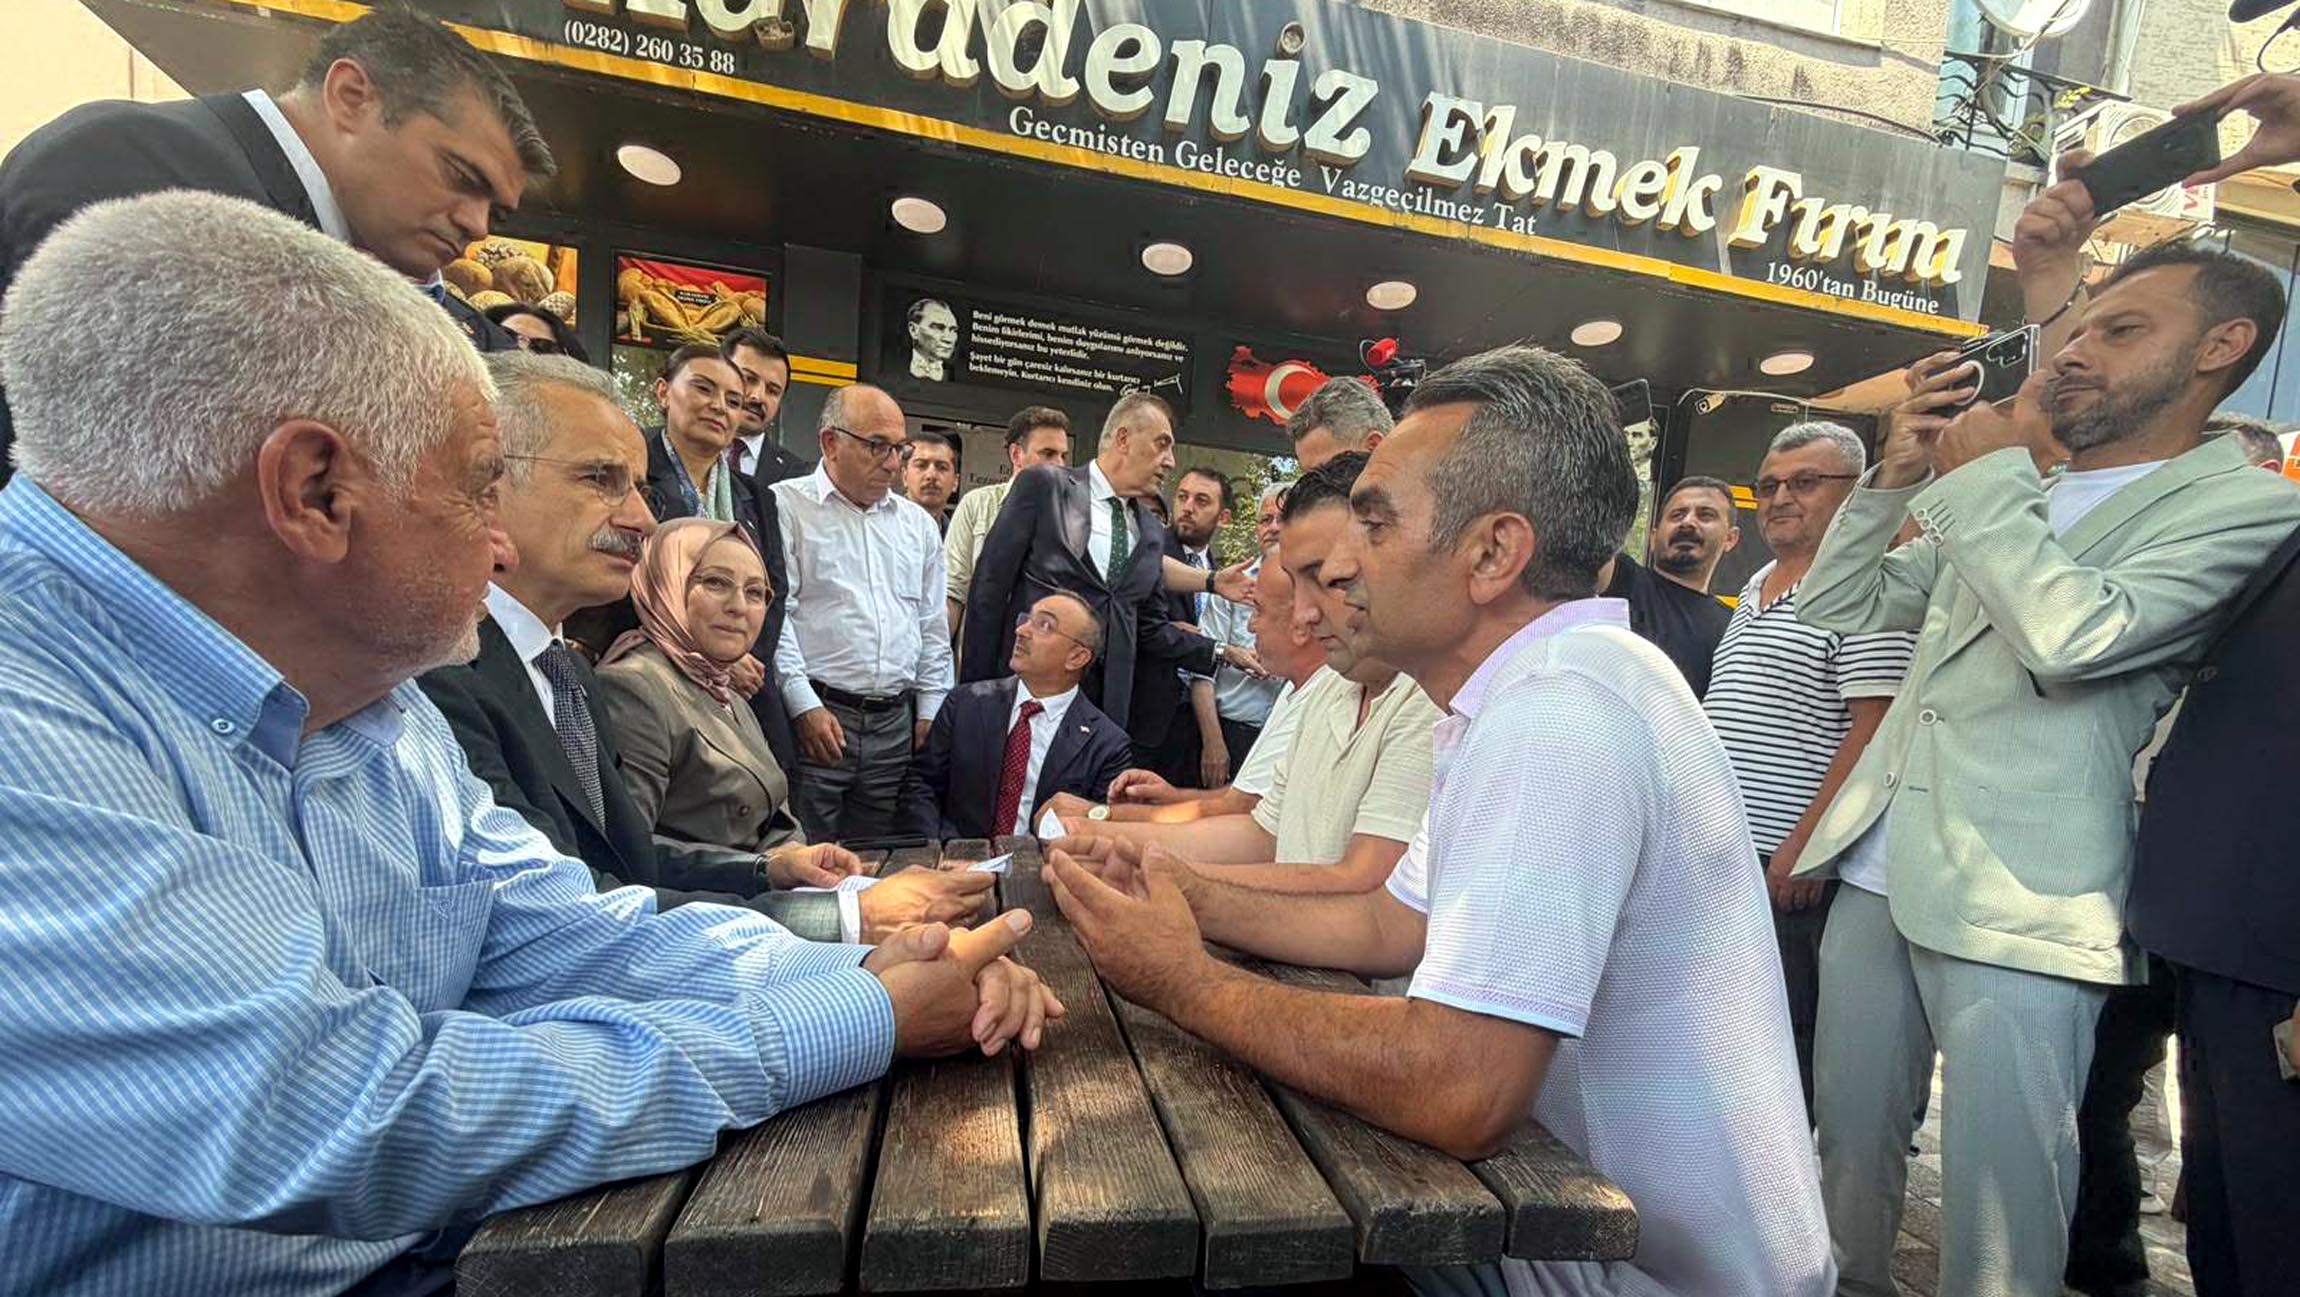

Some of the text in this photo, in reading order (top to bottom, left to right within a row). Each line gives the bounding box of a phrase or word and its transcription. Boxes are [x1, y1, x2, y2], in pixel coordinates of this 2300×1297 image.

[564, 19, 736, 74] (0282) 260 35 88
[1174, 140, 1302, 188] Geleceğe
[1320, 165, 1485, 224] Vazgeçilmez
[1493, 202, 1538, 235] Tat
[1404, 91, 1723, 235] Ekmek
[1727, 165, 1968, 286] Fırını
[1765, 262, 1940, 315] 1960'tan Bugüne
[972, 322, 1000, 335] Benim
[1047, 332, 1074, 346] benim
[973, 310, 992, 321] Beni
[994, 314, 1026, 326] görmek
[1027, 318, 1056, 331] demek
[1058, 325, 1087, 336] mutlak
[1089, 328, 1121, 341] yüzümü
[1122, 335, 1153, 346] görmek
[969, 362, 1019, 378] beklemeyin.
[1057, 375, 1092, 389] kendiniz
[1093, 381, 1115, 392] olun.
[970, 350, 992, 363] Şayet
[1007, 357, 1023, 368] gün
[1025, 361, 1053, 371] çaresiz
[1107, 371, 1141, 384] kurtarıcı
